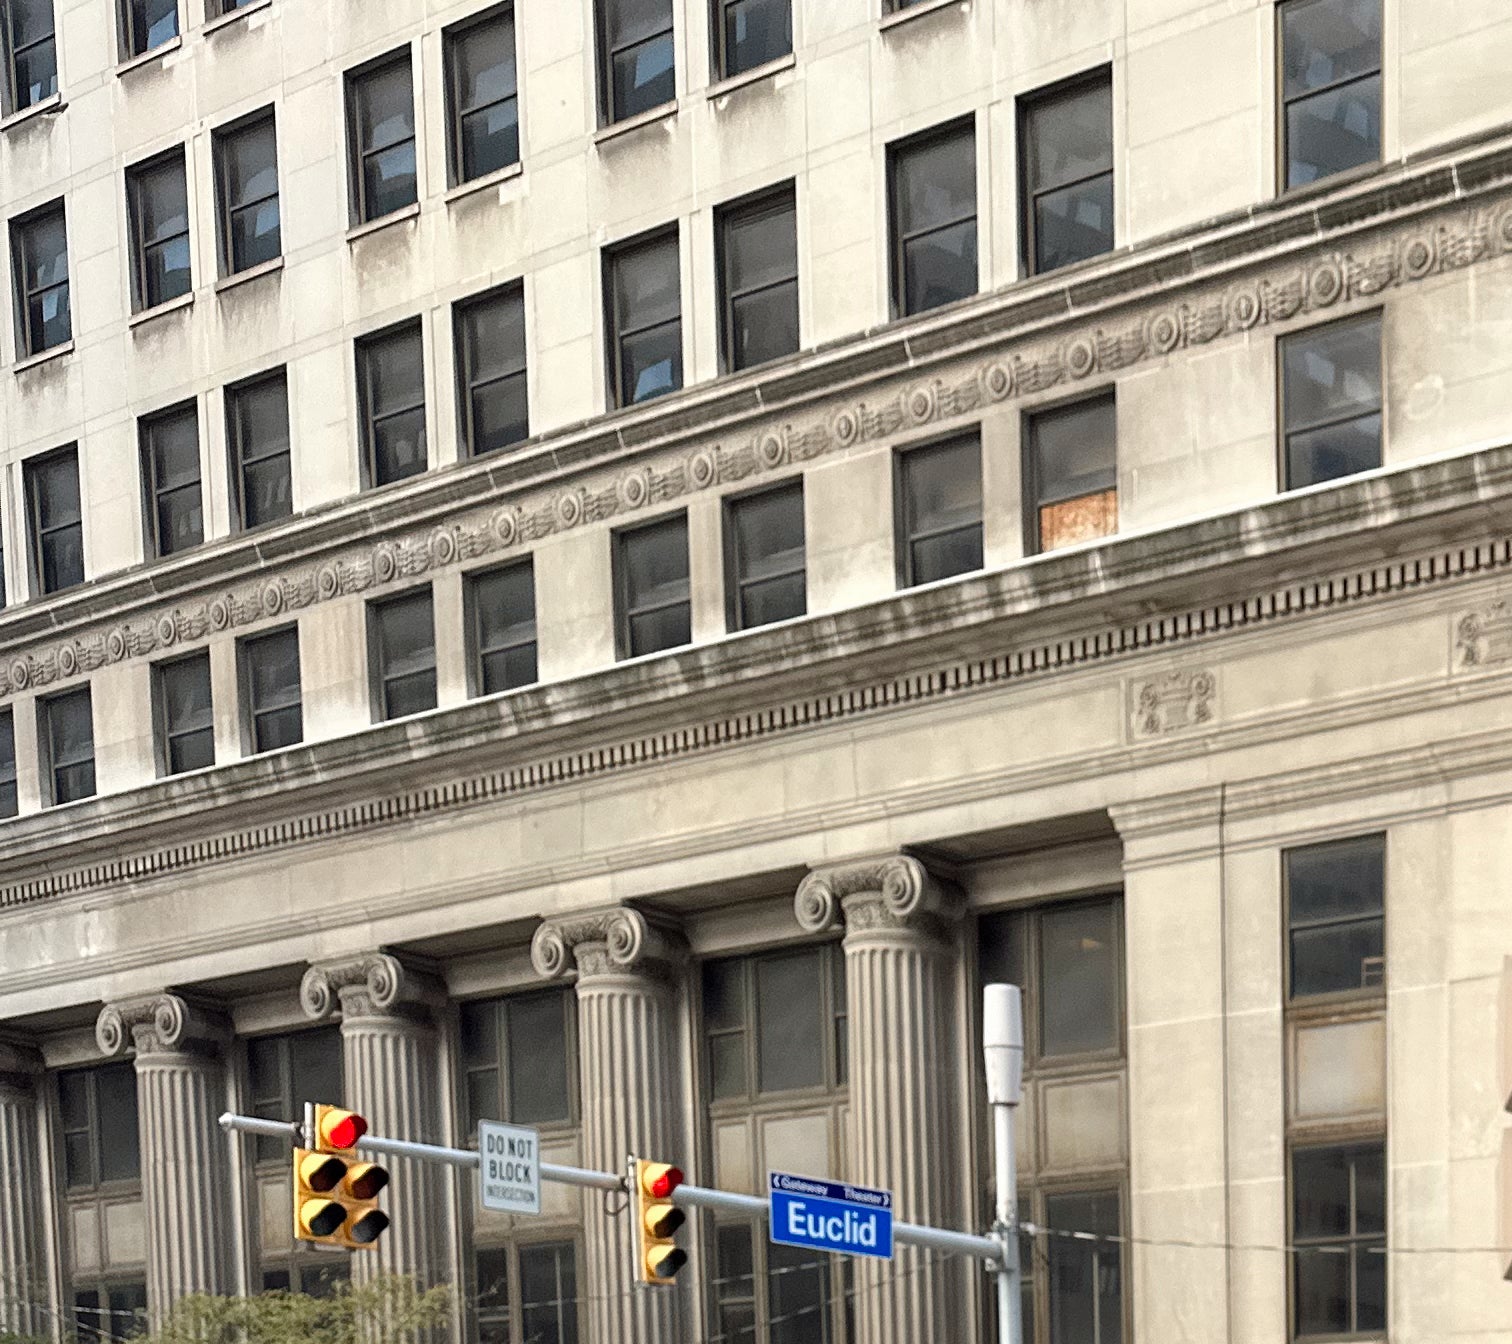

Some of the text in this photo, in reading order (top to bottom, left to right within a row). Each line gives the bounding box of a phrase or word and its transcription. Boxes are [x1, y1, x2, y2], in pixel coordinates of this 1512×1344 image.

[487, 1133, 532, 1160] DO NOT
[489, 1159, 532, 1184] BLOCK
[788, 1200, 877, 1248] Euclid
